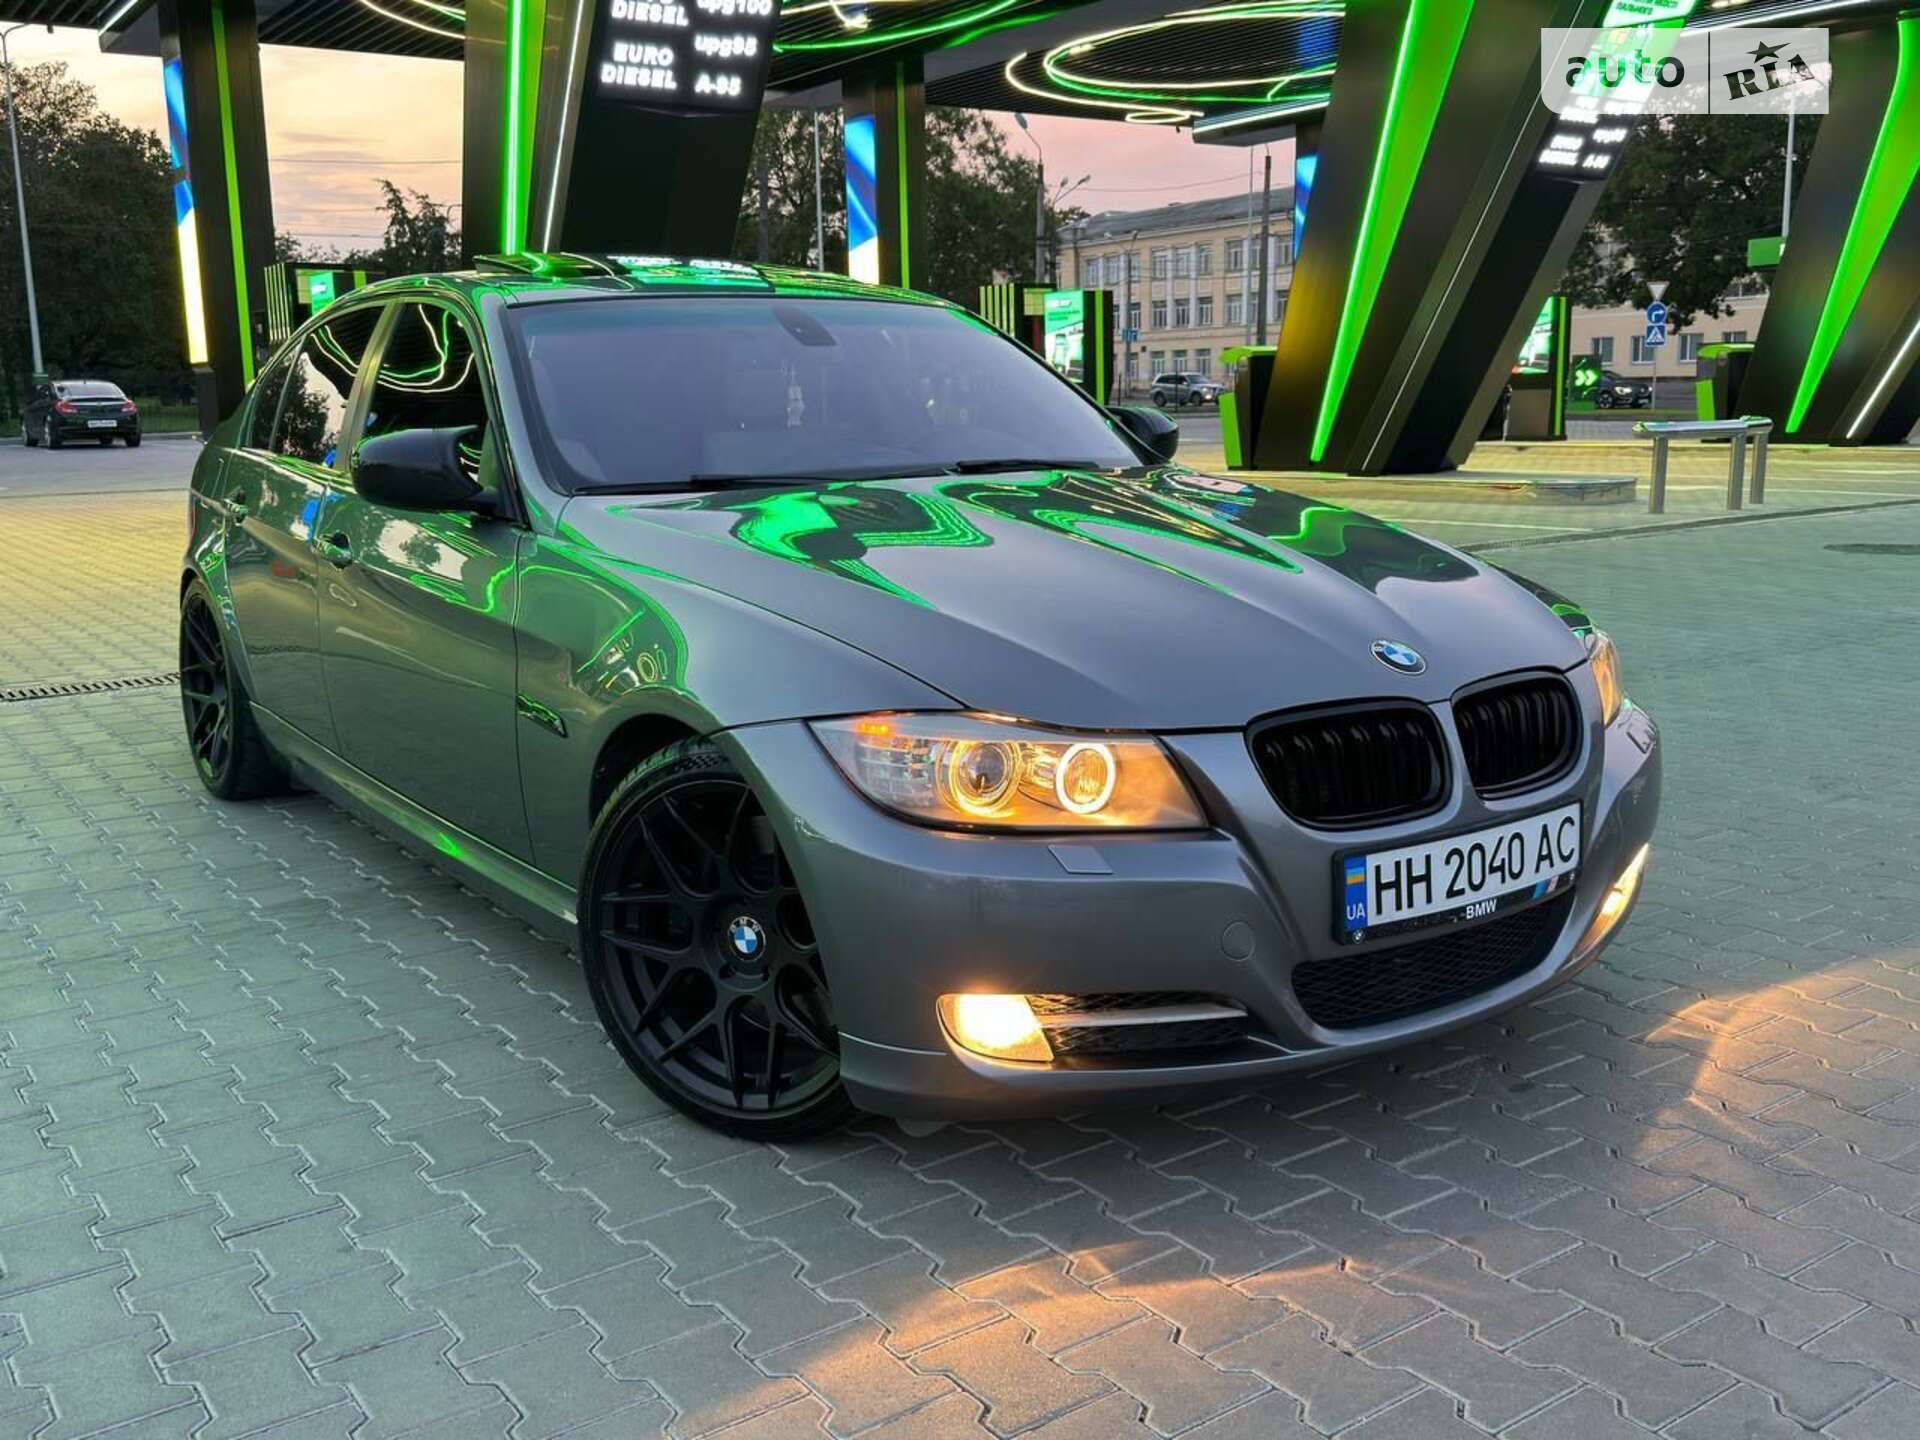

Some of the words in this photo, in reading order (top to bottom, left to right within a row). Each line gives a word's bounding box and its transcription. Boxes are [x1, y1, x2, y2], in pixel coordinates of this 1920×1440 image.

[611, 0, 689, 26] DIESEL
[613, 41, 674, 66] EURO
[600, 64, 677, 90] DIESEL
[1374, 853, 1432, 915] HH
[1444, 832, 1525, 899] 2040
[1535, 816, 1576, 873] AC
[1346, 902, 1366, 920] UA
[1466, 899, 1497, 919] BMW
